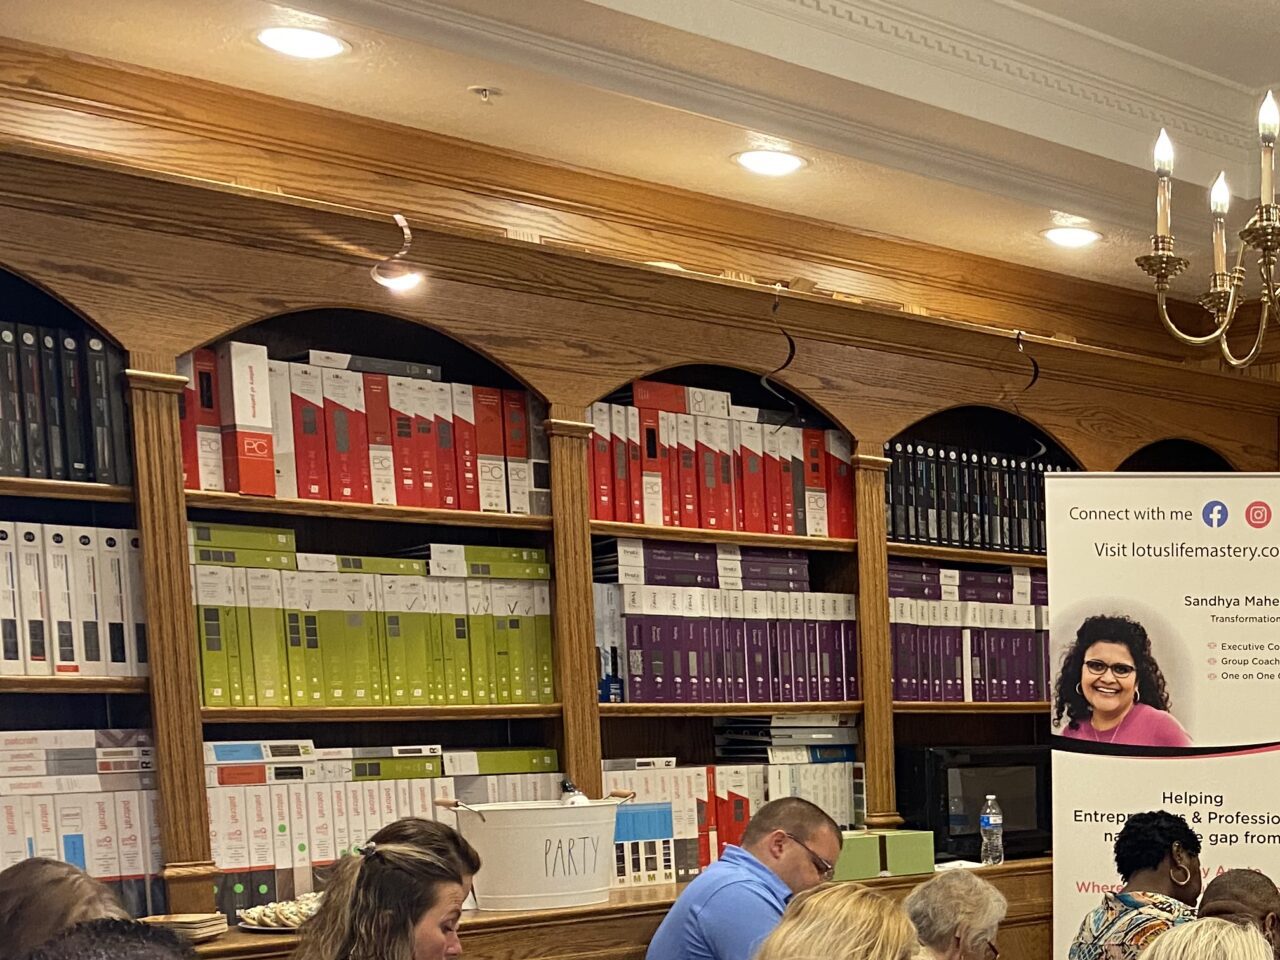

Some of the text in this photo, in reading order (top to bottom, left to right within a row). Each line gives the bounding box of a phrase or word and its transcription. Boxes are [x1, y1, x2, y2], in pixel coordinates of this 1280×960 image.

[244, 439, 268, 455] PC
[480, 465, 503, 479] PC
[808, 497, 825, 508] PC
[1069, 506, 1193, 520] Connect with me
[1094, 542, 1127, 557] Visit
[1184, 595, 1240, 608] Sandhya
[1221, 642, 1265, 651] Executive
[1221, 657, 1249, 666] Group
[1221, 672, 1240, 680] One
[1256, 672, 1275, 680] One
[141, 760, 152, 769] R
[384, 787, 393, 814] patcraft
[1162, 791, 1224, 807] Helping
[121, 800, 133, 829] patcraft
[1191, 811, 1202, 824] &
[1208, 833, 1239, 846] gap
[544, 836, 599, 877] PARTY
[664, 872, 672, 880] M
[1076, 881, 1124, 893] Where
